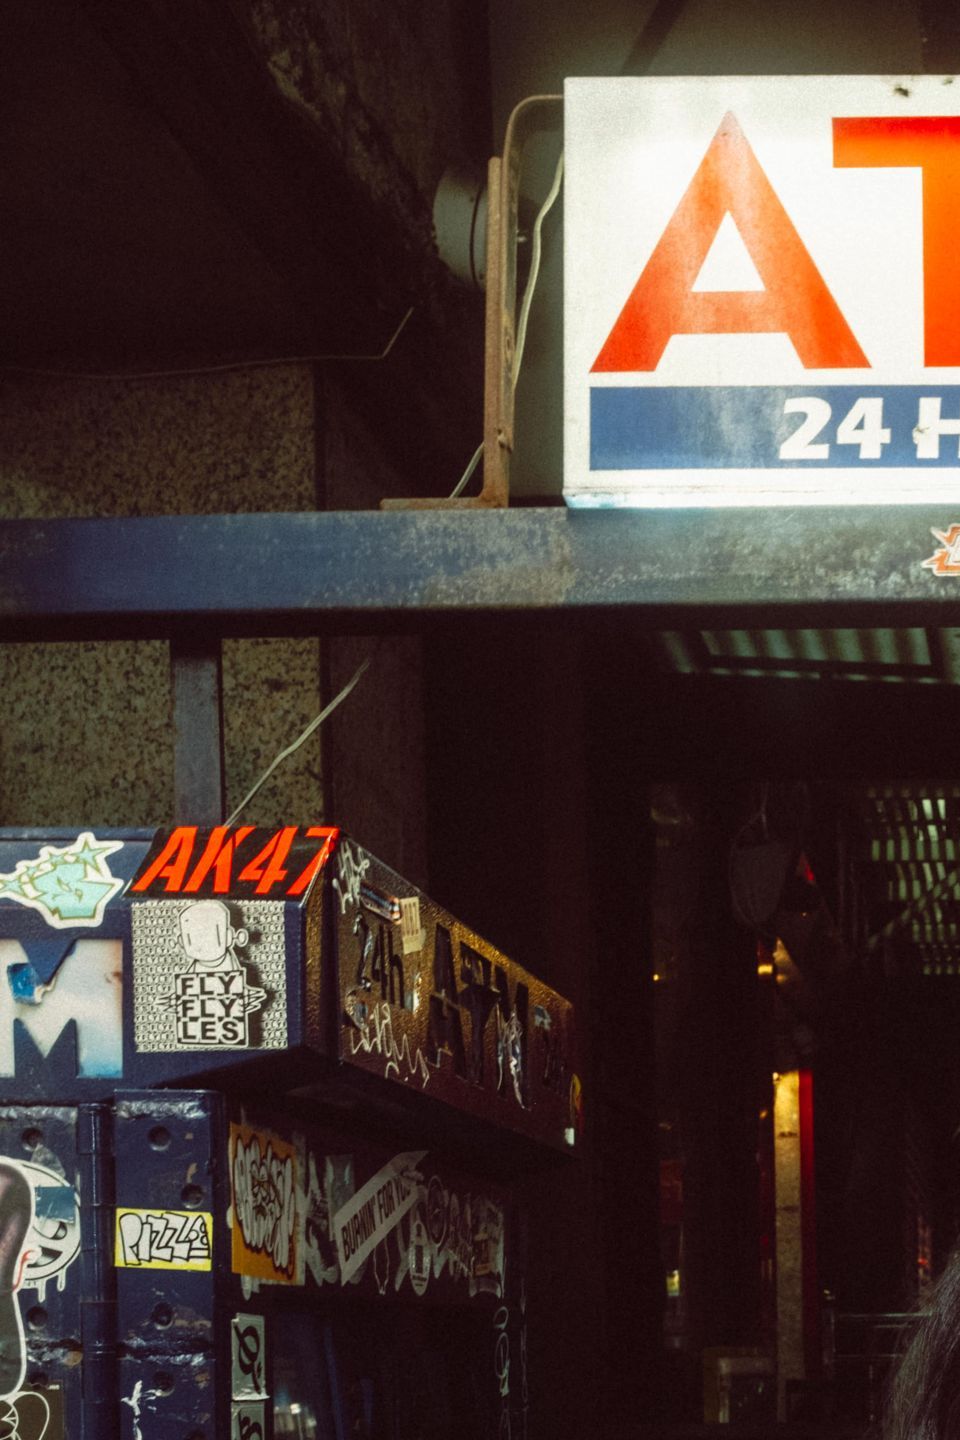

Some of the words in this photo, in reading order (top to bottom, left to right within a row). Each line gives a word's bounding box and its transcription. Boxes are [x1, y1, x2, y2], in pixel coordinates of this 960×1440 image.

[778, 396, 891, 460] 24
[131, 826, 339, 895] AK47
[180, 976, 237, 996] FLY
[181, 999, 238, 1018] FLY
[182, 1020, 239, 1042] LES
